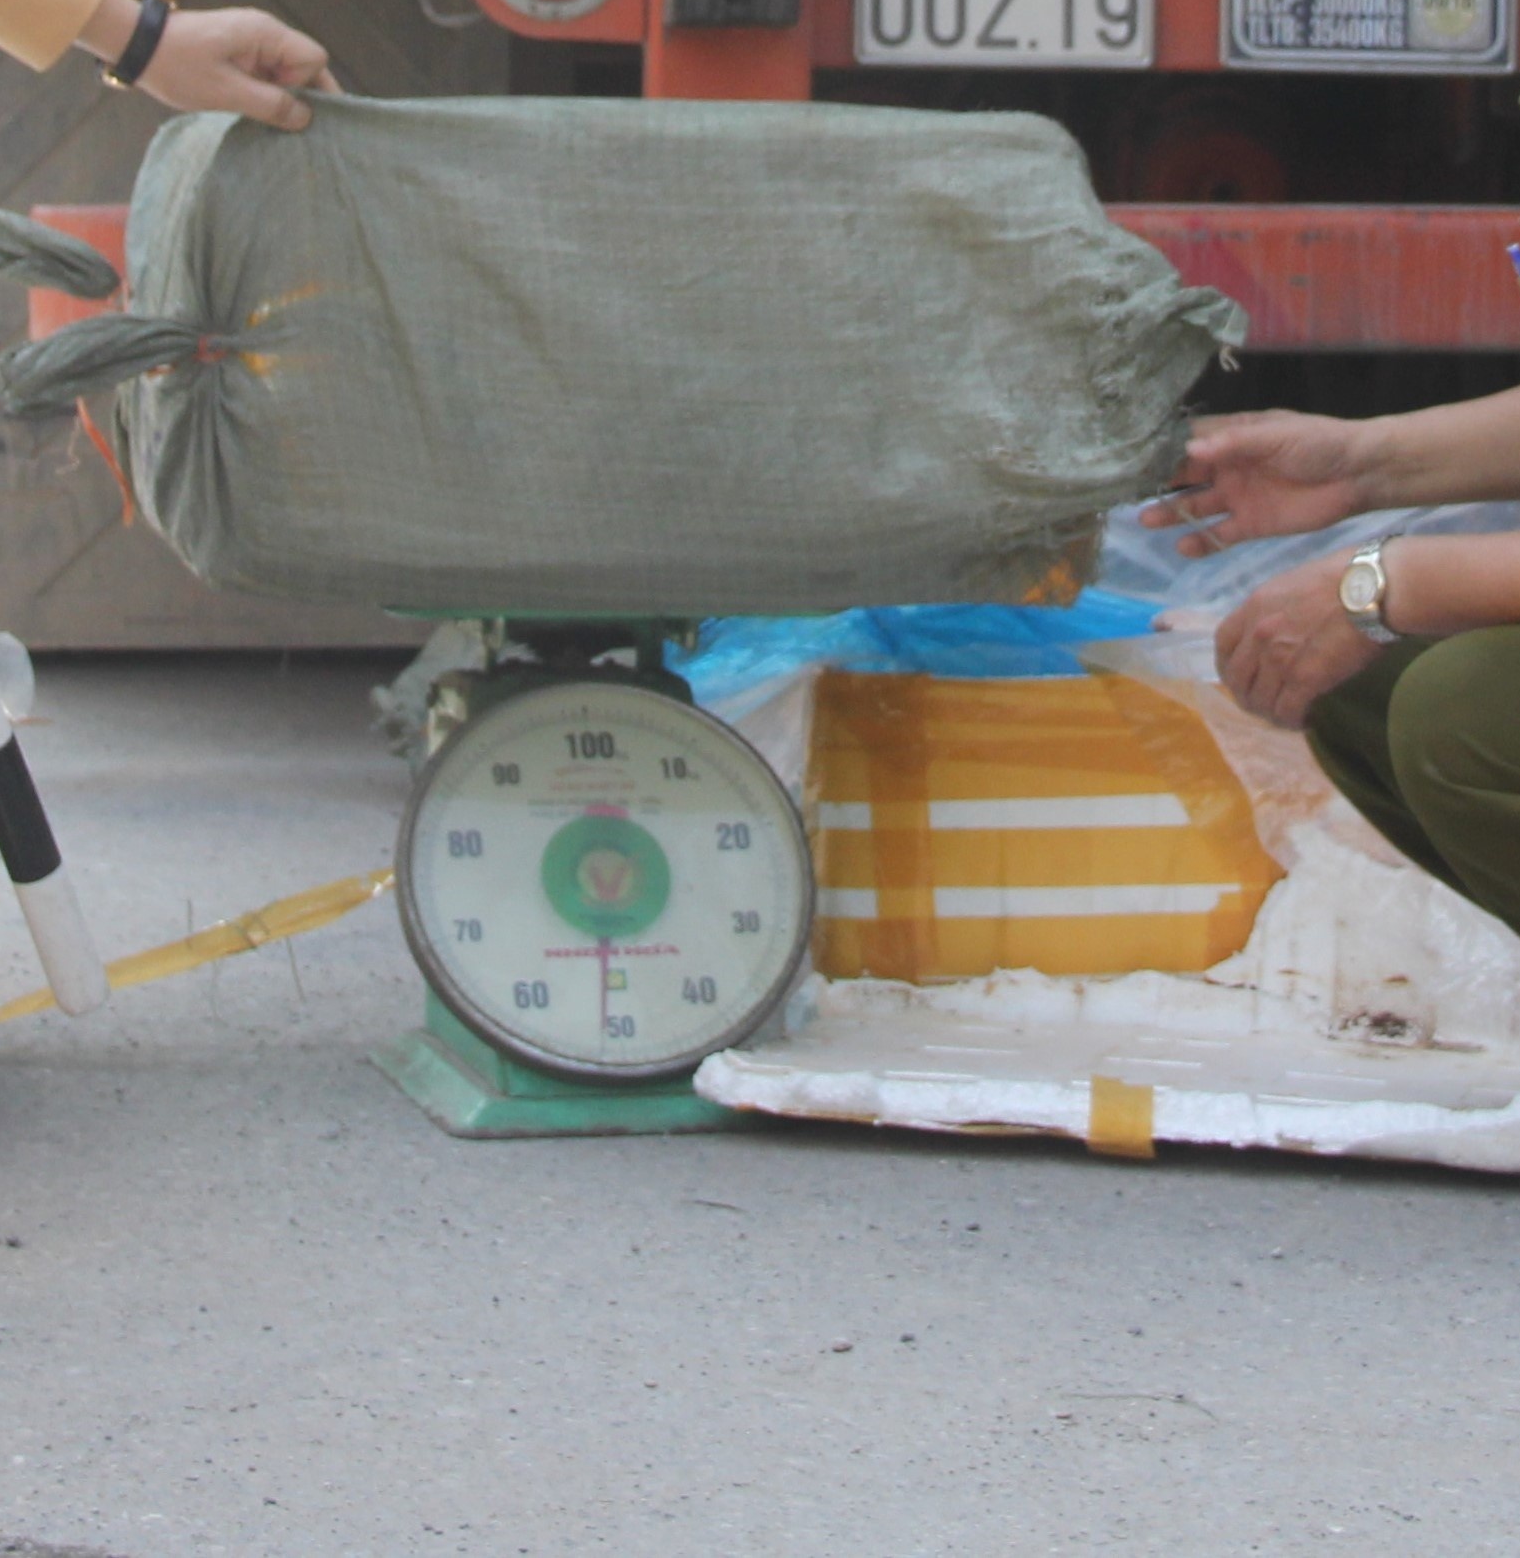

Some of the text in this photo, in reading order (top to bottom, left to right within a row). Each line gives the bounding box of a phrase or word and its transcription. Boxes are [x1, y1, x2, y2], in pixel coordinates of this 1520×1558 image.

[565, 731, 616, 760] 100
[492, 762, 521, 787] 90
[661, 756, 688, 781] 10
[448, 829, 484, 858] 80
[716, 823, 751, 851] 20
[453, 918, 483, 942] 70
[731, 910, 761, 935] 30
[513, 980, 551, 1010] 60
[681, 976, 717, 1005] 40
[606, 1014, 636, 1039] 50
